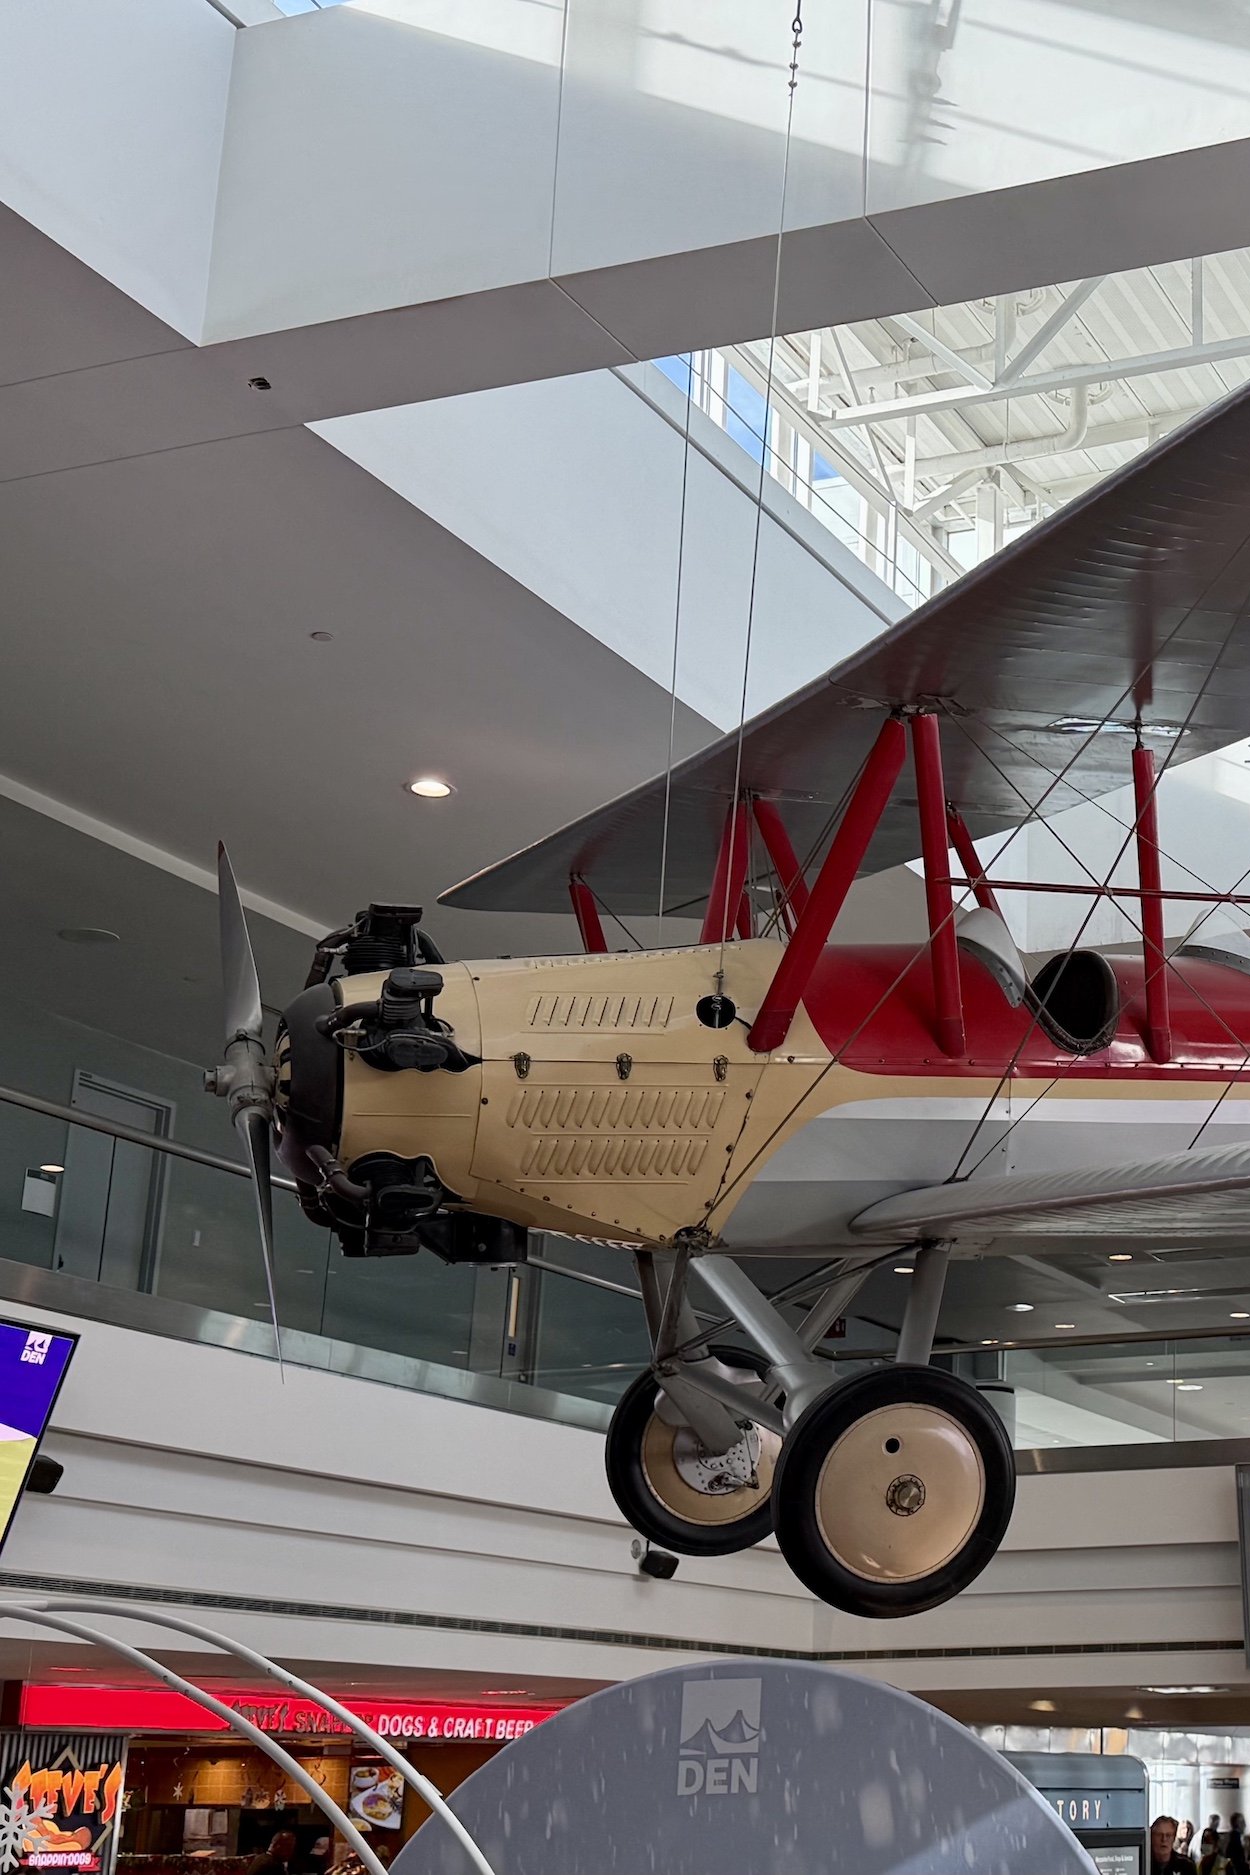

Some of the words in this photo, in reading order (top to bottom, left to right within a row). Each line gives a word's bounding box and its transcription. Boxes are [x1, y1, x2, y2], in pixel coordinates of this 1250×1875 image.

[20, 1349, 47, 1365] DEN
[378, 1714, 424, 1737] DOGS
[427, 1718, 438, 1738] &
[443, 1717, 494, 1739] CRAFT
[677, 1758, 759, 1796] DEN
